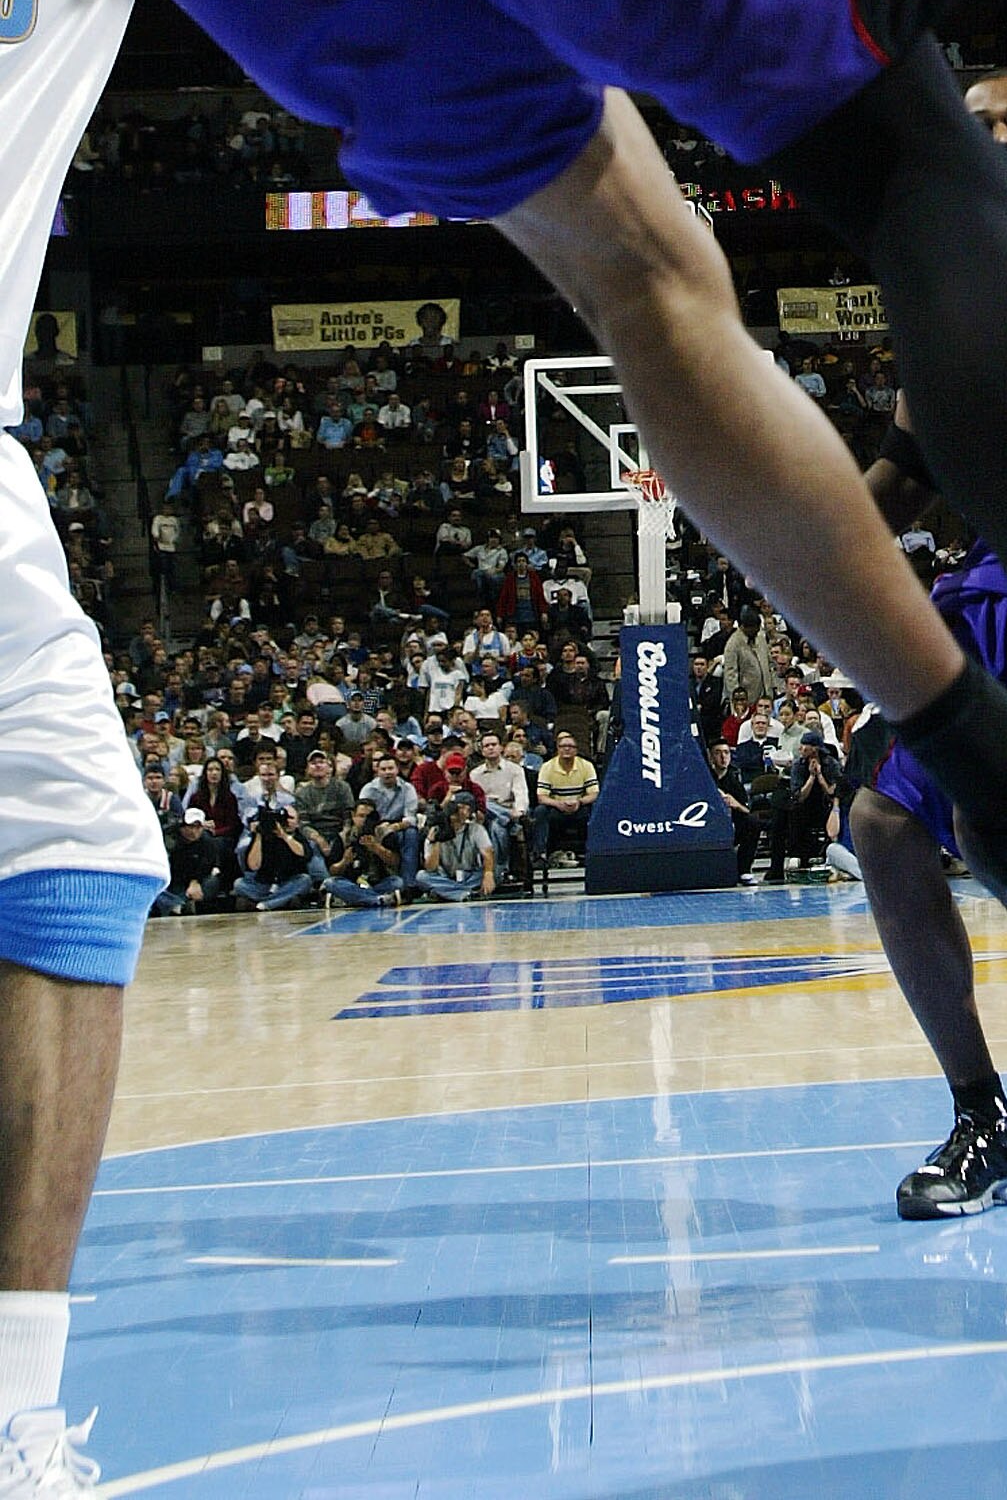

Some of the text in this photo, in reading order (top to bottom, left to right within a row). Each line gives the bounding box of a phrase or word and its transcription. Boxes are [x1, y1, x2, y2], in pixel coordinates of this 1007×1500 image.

[320, 310, 384, 326] Andre's
[320, 326, 406, 343] Little PGs
[617, 819, 673, 836] Qwest
